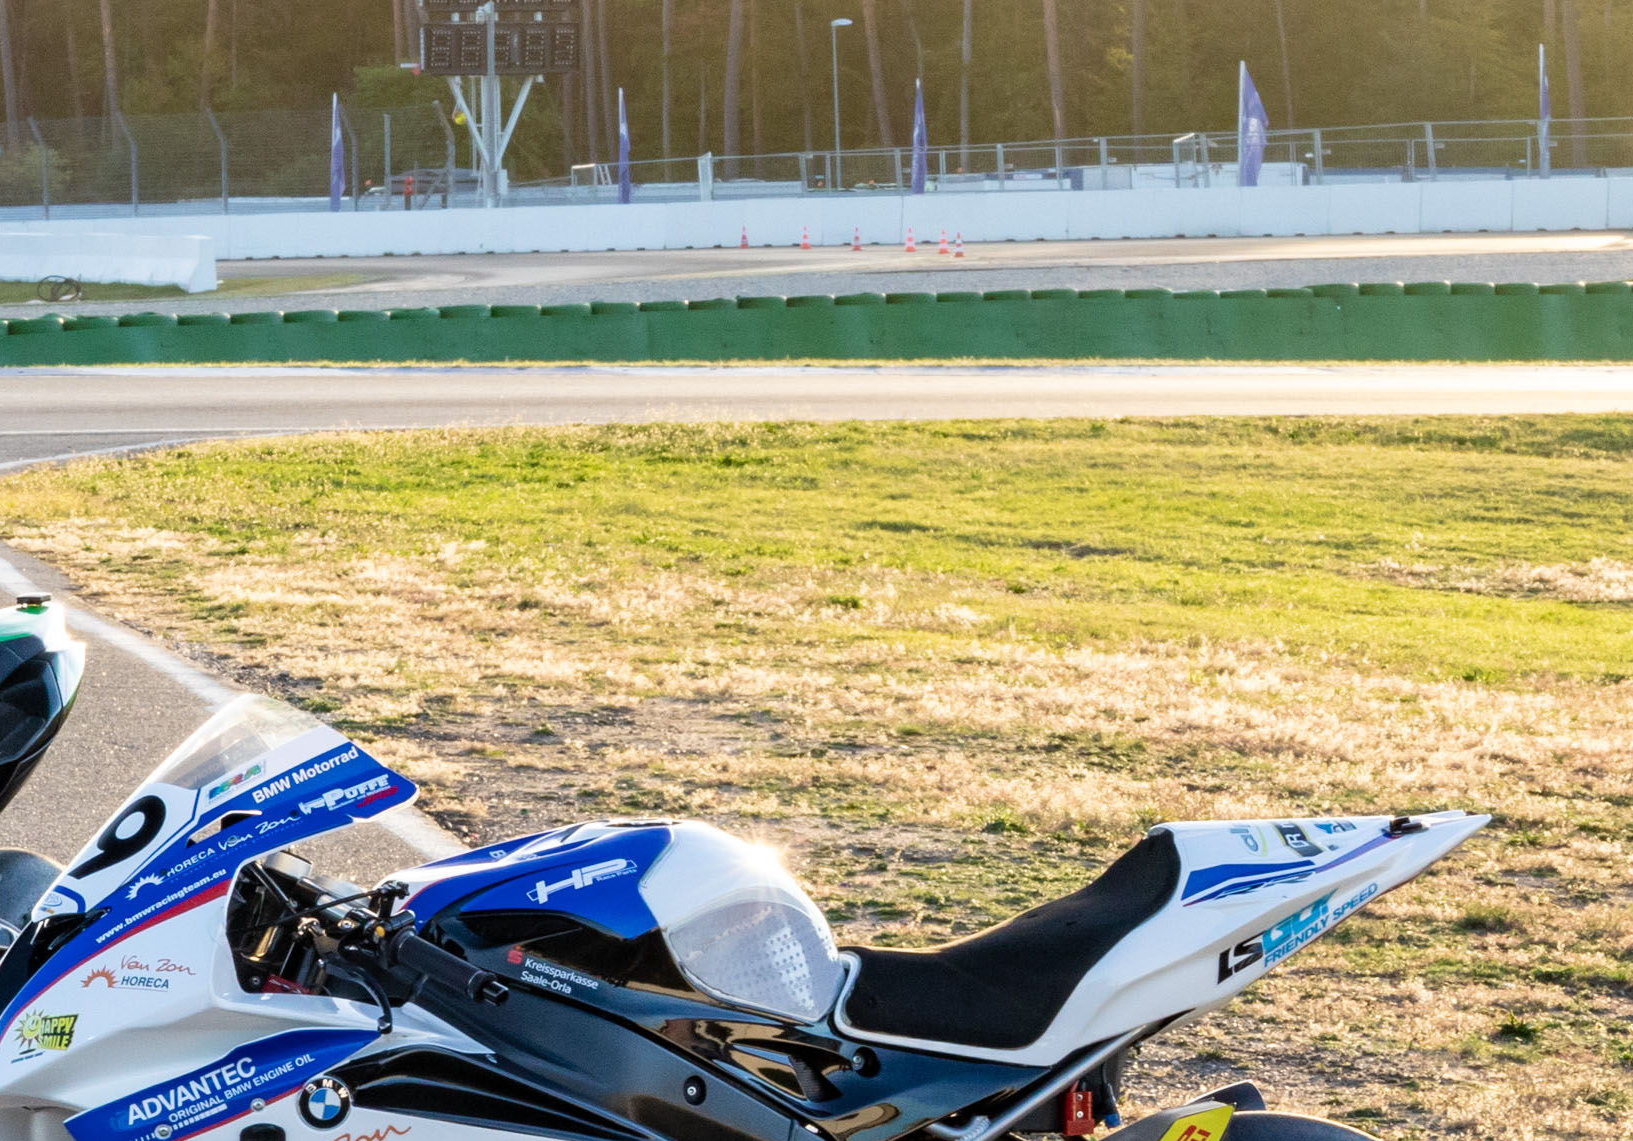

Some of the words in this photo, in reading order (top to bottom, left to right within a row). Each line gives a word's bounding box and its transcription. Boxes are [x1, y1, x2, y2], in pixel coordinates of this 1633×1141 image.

[251, 776, 292, 804] BMW
[290, 745, 360, 788] Motorrad
[67, 793, 168, 880] 9
[166, 846, 217, 878] HORECA
[94, 867, 228, 945] www.bmwracingteam.eu
[1263, 914, 1330, 968] FRIENDLY
[1332, 881, 1379, 921] SPEED
[119, 953, 154, 973] Van
[156, 956, 198, 976] Zon
[524, 957, 600, 990] Kreissparkasse
[120, 975, 170, 991] HORECA
[520, 969, 573, 996] Saale-Orla
[39, 1014, 75, 1035] HAPPY
[37, 1033, 72, 1050] SMILE
[127, 1056, 258, 1126] ADVANTEC
[167, 1094, 224, 1124] ORIGINAL
[223, 1083, 253, 1099] BMW
[252, 1064, 296, 1088] ENGINE
[294, 1053, 316, 1071] OIL
